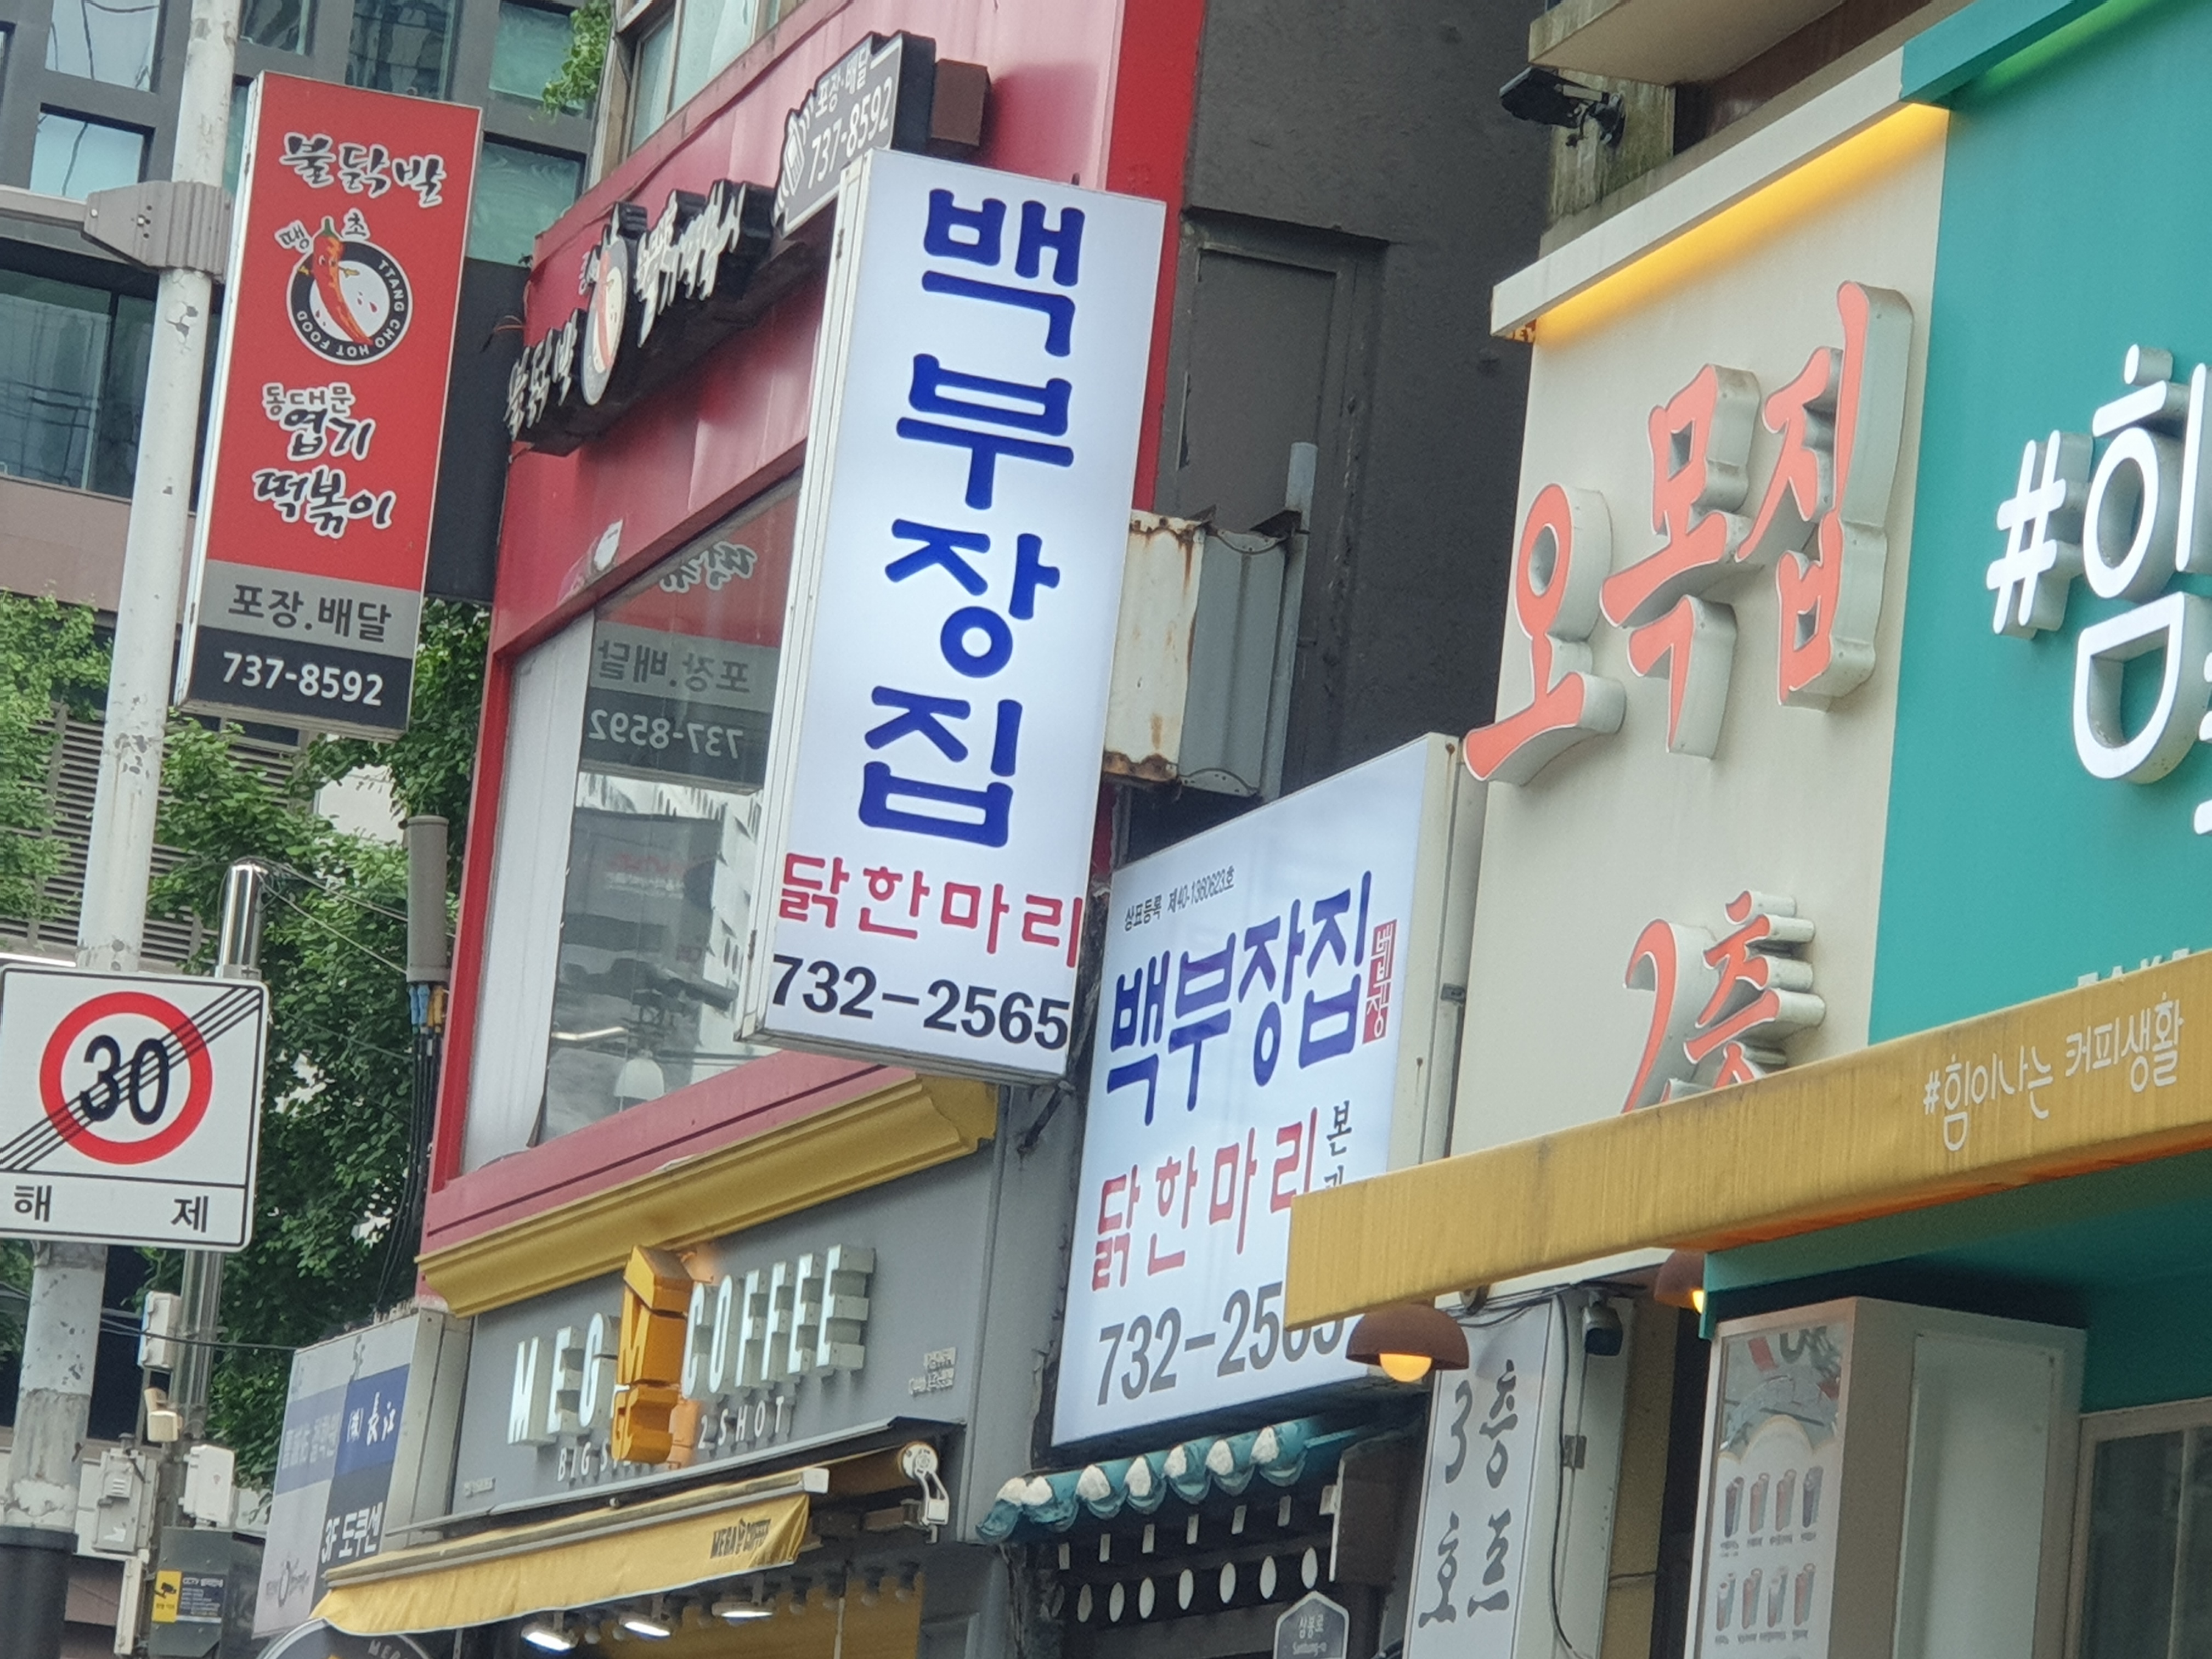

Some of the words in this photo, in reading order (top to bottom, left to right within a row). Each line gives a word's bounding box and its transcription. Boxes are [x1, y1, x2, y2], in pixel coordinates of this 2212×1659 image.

[279, 132, 447, 208] 불닭발
[808, 76, 893, 191] 737-8592
[378, 259, 405, 312] TTANG
[296, 310, 330, 351] FOOD
[335, 344, 370, 358] HOT
[375, 318, 401, 349] CHO
[263, 382, 355, 419] 동대문
[280, 408, 376, 460] 엽기
[252, 465, 396, 538] 떡볶이
[859, 189, 1085, 848] 백부장집
[1464, 280, 1872, 782] 오목집
[228, 583, 392, 643] 포장.배달
[222, 651, 383, 707] 737-8592
[779, 853, 1083, 968] 닭한마리
[1124, 894, 1163, 932] 상표등록
[772, 954, 1070, 1050] 732-2565
[1107, 870, 1372, 1126] 백부장집
[80, 1035, 169, 1125] 30
[1923, 1045, 2053, 1152] #힘이나는
[2065, 991, 2184, 1093] 커피생활
[1092, 1107, 1317, 1291] 닭한마리
[507, 1312, 629, 1445] MEG
[681, 1244, 849, 1399] COFFEE
[1445, 1359, 1518, 1488] 3층
[557, 1441, 591, 1481] BIG
[321, 1514, 341, 1564] 3F
[338, 1502, 383, 1558] 도쿠센
